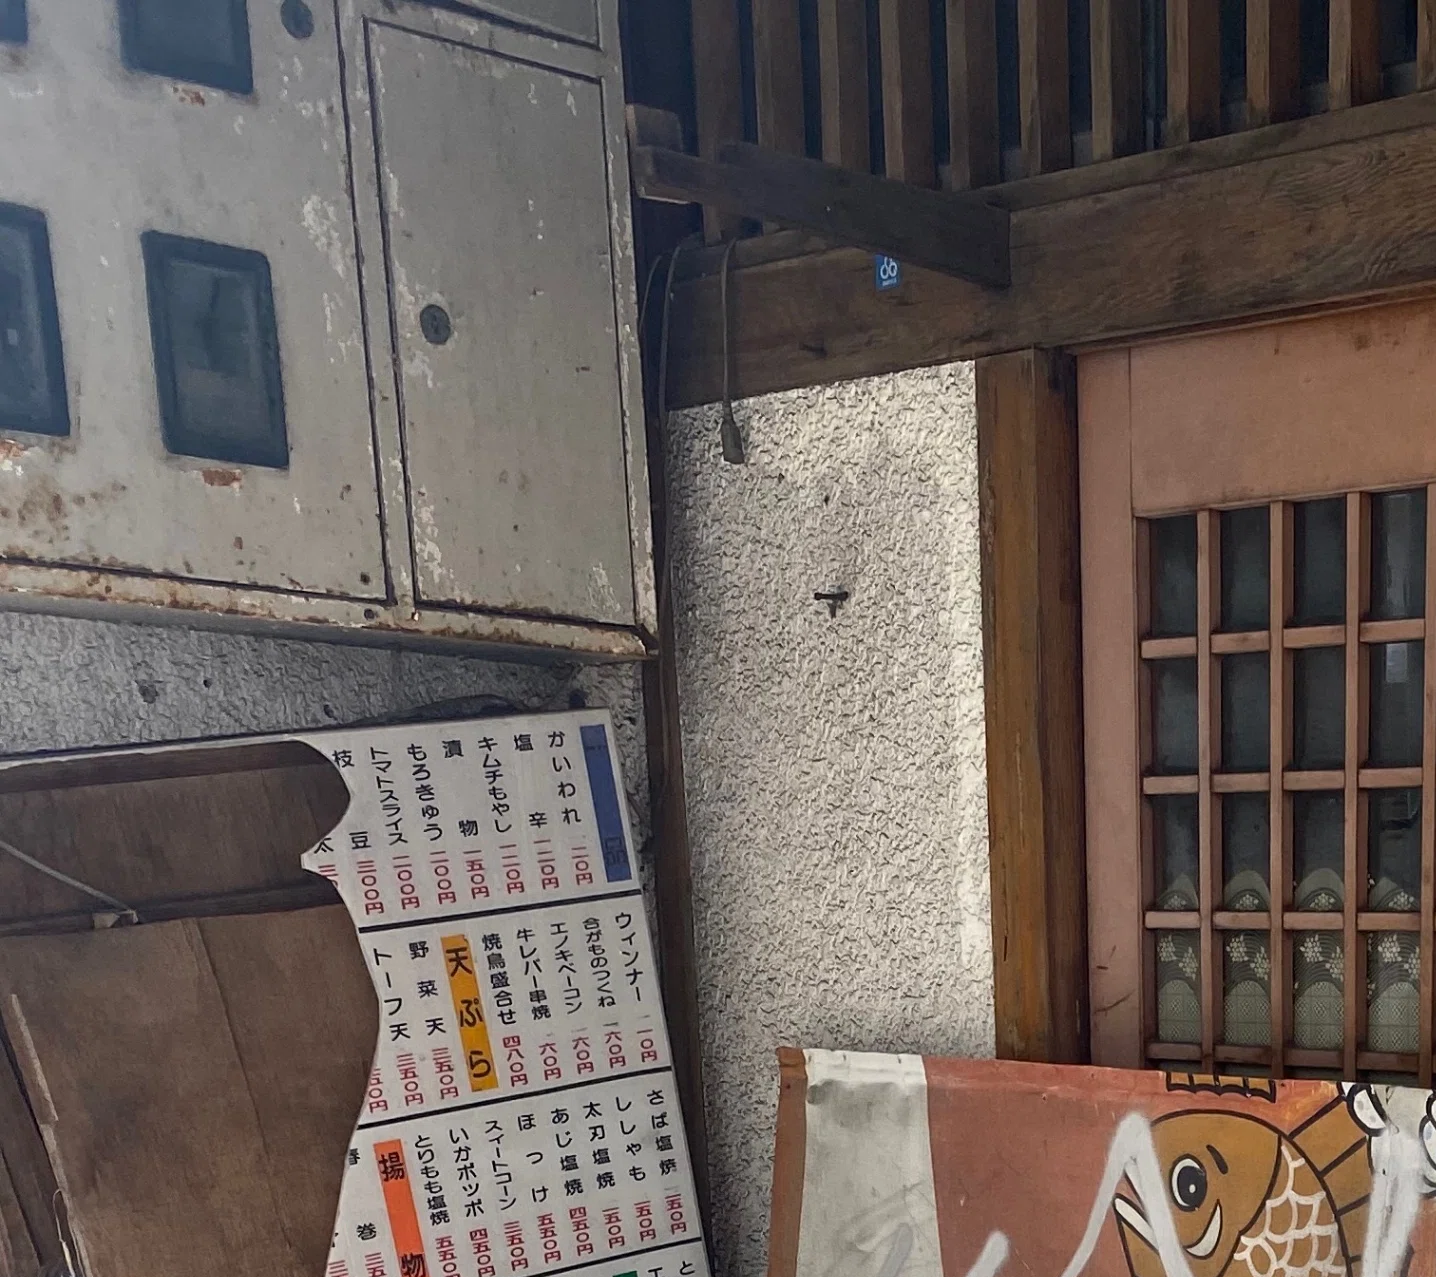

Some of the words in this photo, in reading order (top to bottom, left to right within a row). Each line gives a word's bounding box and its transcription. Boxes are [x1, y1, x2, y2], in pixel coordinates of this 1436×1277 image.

[332, 750, 371, 849] 枝豆
[370, 747, 408, 845] トマトスライス
[407, 744, 442, 841] もろきゅう
[442, 740, 478, 837] 漬物
[478, 737, 512, 832] キムチもやし
[514, 734, 547, 828] 塩辛
[548, 731, 581, 824] かいわれ
[373, 948, 410, 1041] トーフ天
[409, 941, 446, 1035] 野菜天
[482, 933, 516, 1025] 焼鳥盛合せ
[517, 928, 551, 1020] 牛レバー串焼
[551, 923, 582, 1014] エノキベーコン
[583, 918, 616, 1007] 合がものつくね
[615, 912, 643, 1001] ウィンナー
[445, 947, 491, 1078] 天ぷら
[551, 1108, 583, 1196] あじ塩焼
[616, 1097, 645, 1181] ししゃも
[647, 1090, 676, 1175] さば塩焼
[415, 1135, 450, 1226] とりもも塩焼
